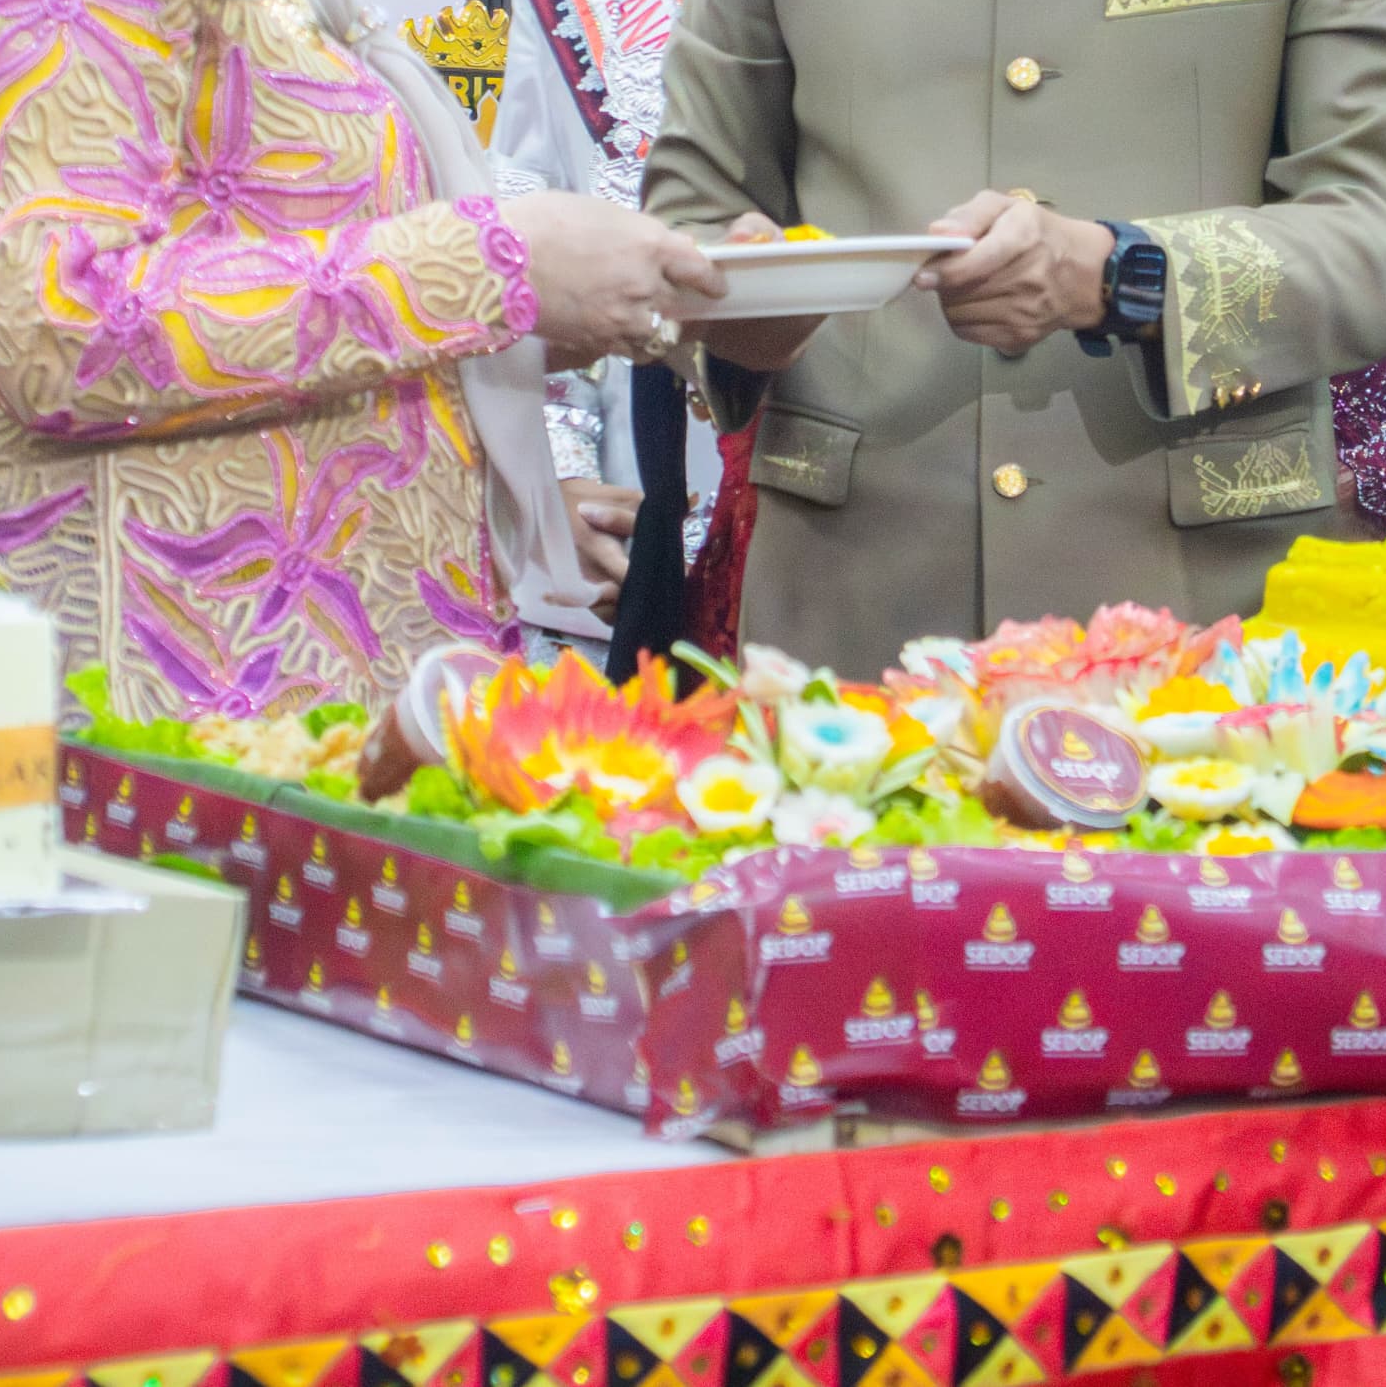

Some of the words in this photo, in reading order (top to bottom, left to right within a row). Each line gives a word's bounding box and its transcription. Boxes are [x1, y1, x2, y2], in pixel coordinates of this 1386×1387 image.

[834, 865, 908, 895] SEDOP
[1046, 882, 1114, 908] SEDOP
[759, 932, 833, 963] SEDOP
[965, 941, 1035, 966] SEDOP
[1118, 942, 1185, 966] SEDOP
[1263, 943, 1327, 967] SEDOP
[844, 1015, 914, 1044] SEDOP
[1041, 1027, 1108, 1052] SEDOP
[1186, 1027, 1252, 1050] SEDOP
